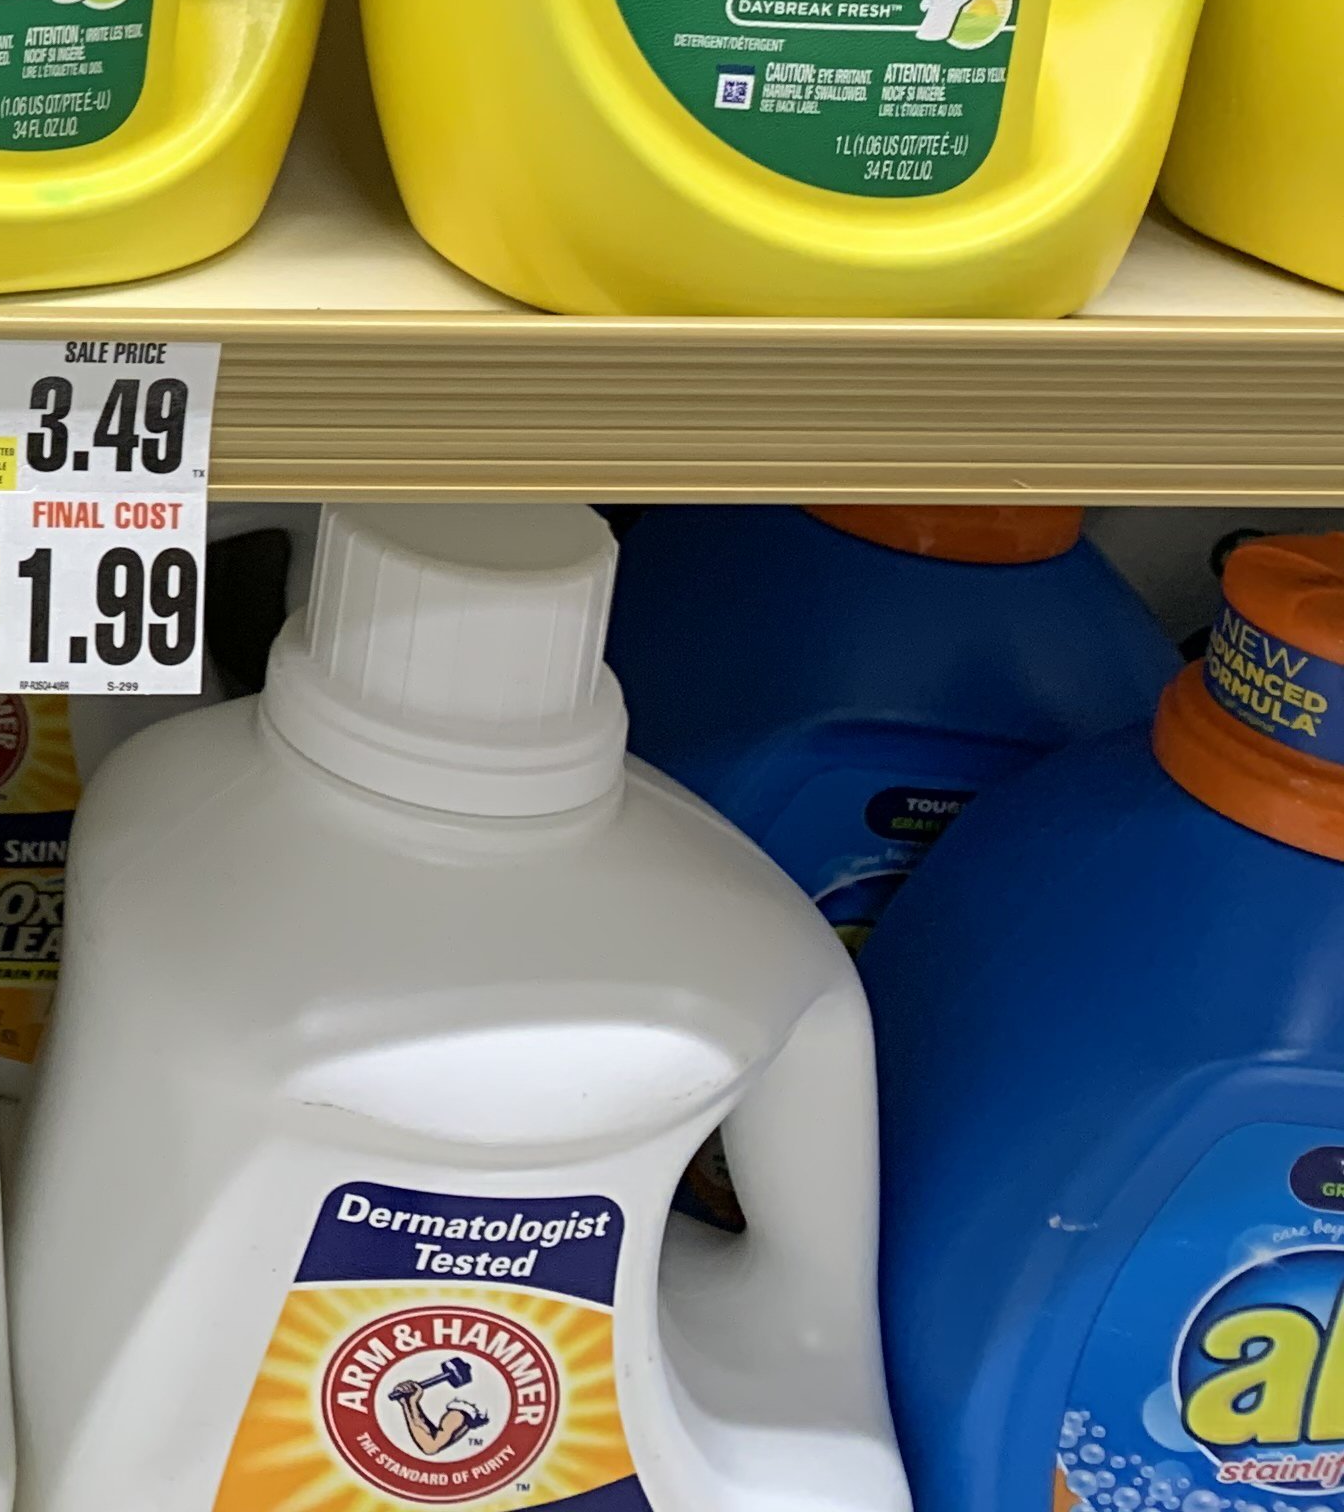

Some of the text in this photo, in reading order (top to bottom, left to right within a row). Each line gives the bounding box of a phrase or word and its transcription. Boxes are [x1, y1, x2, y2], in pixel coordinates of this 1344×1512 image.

[739, 0, 832, 17] DAYBREAK
[65, 341, 167, 364] SALE PRICE
[26, 376, 189, 474] 3.49
[32, 501, 183, 530] FINAL COST
[18, 547, 198, 666] 1.99
[1222, 608, 1308, 678] NEW
[107, 682, 139, 692] S-299
[337, 1193, 611, 1248] Dermatologist
[414, 1244, 539, 1278] Tested
[337, 1318, 548, 1426] ARM & HAMMER
[1222, 1455, 1344, 1485] stainlif
